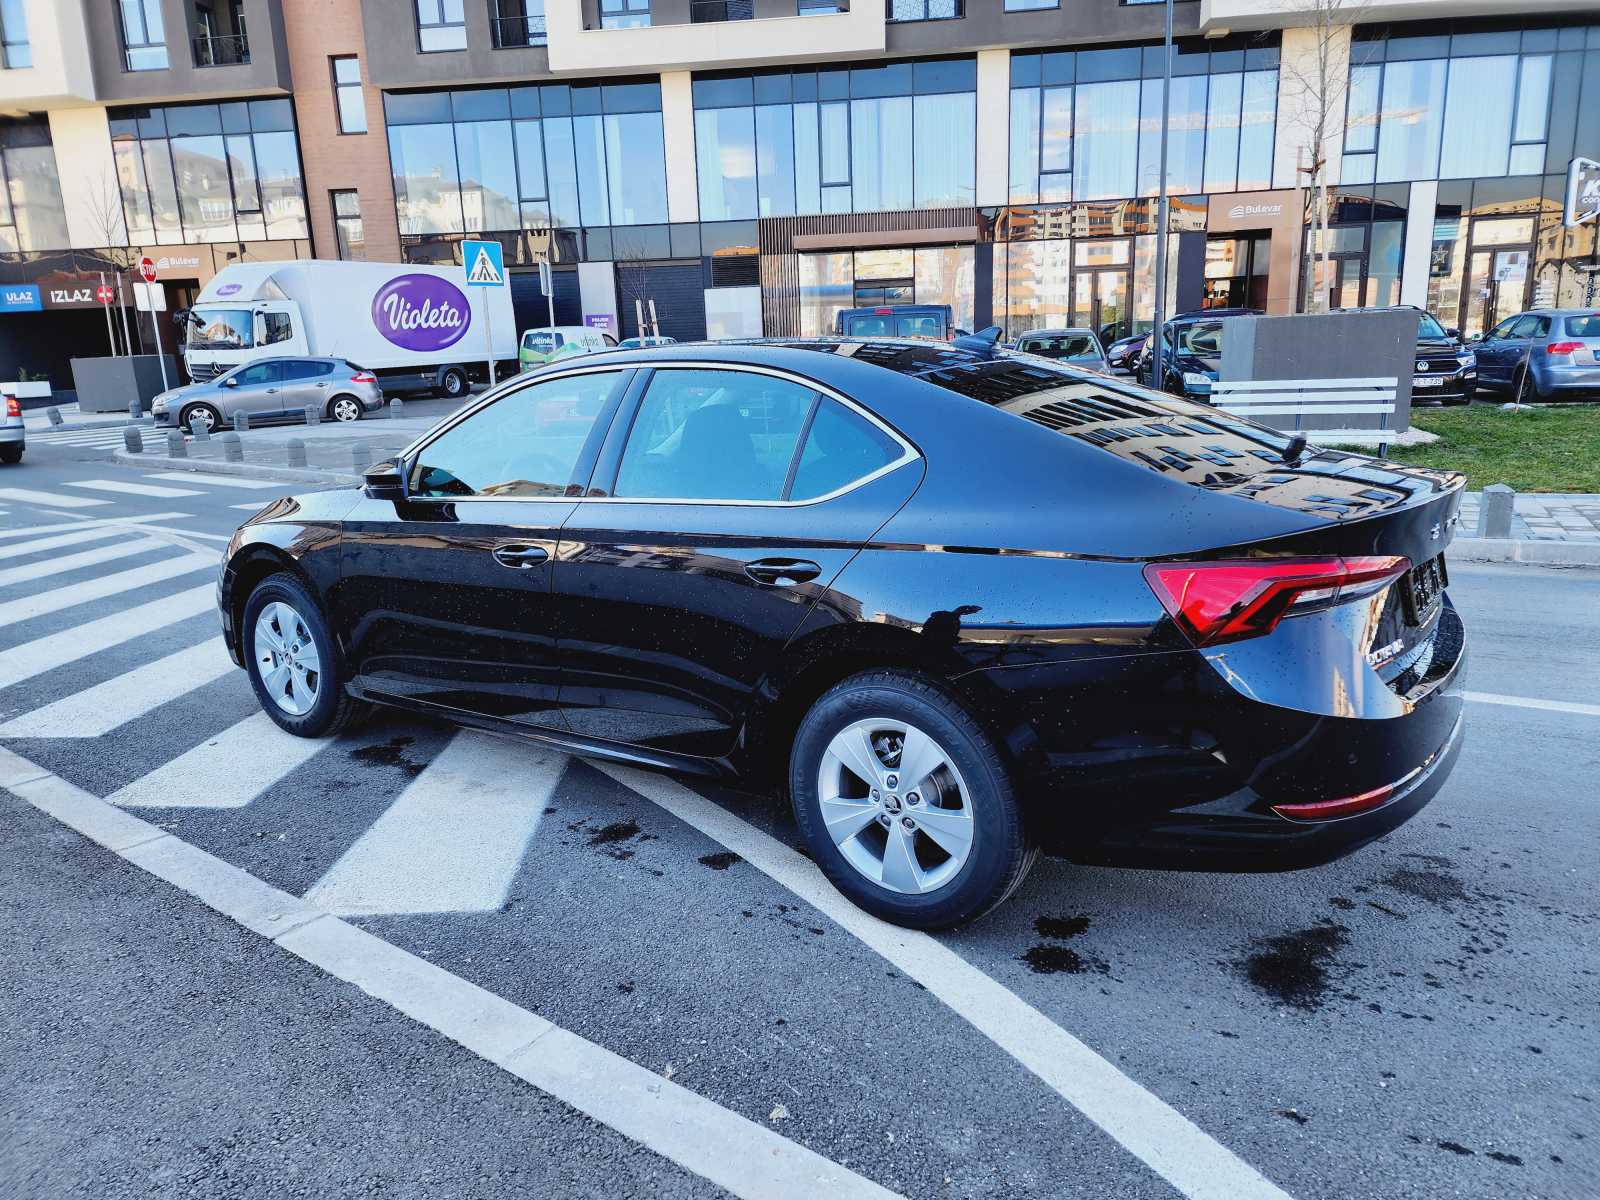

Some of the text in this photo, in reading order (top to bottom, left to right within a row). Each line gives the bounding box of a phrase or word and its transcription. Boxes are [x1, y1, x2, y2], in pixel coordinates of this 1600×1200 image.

[141, 263, 157, 276] STOP
[6, 291, 33, 301] ULAZ
[50, 289, 93, 303] IZLAZ
[383, 293, 461, 330] Violeta
